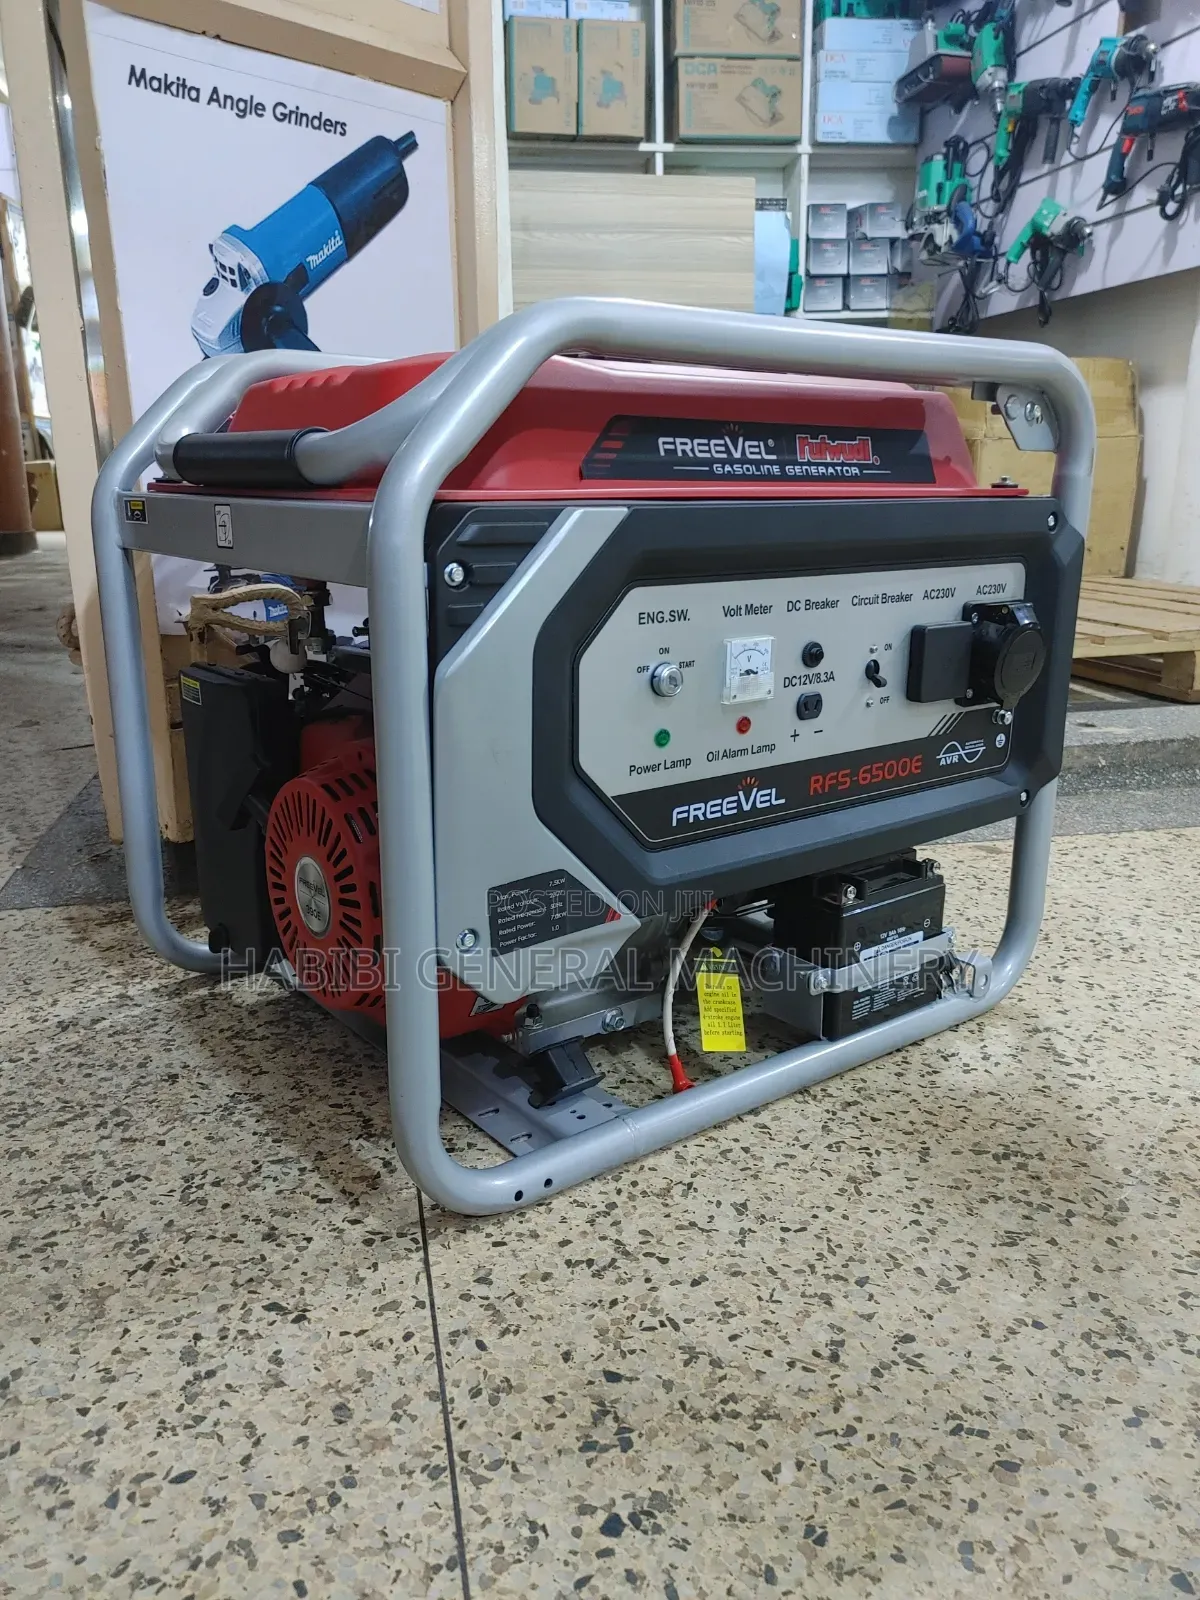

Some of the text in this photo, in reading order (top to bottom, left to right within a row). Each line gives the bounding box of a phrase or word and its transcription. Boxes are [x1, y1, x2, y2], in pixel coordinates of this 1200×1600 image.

[684, 63, 718, 76] DCA
[128, 64, 348, 137] Makita Angle Grinders
[713, 463, 860, 476] GASOLINE GENERATOR
[923, 587, 956, 601] AC230V
[976, 583, 1007, 595] AC230V
[786, 598, 839, 612] DC Breaker
[851, 592, 913, 607] Circuit Breaker
[638, 609, 691, 625] ENG.SW.
[722, 603, 773, 618] Volt Meter
[659, 647, 670, 655] ON
[884, 643, 893, 651] ON
[636, 665, 650, 674] OFF
[679, 660, 695, 669] START
[783, 671, 835, 688] DC12V/8.3A
[879, 696, 890, 704] OFF
[706, 742, 776, 763] Oil Alarm Lamp
[629, 756, 692, 777] Power Lamp
[939, 755, 959, 767] AVR
[809, 754, 923, 796] RFS-6500E
[672, 787, 786, 827] FREEVEL
[499, 921, 537, 936] Rated Power:
[499, 932, 538, 947] Power Factor:
